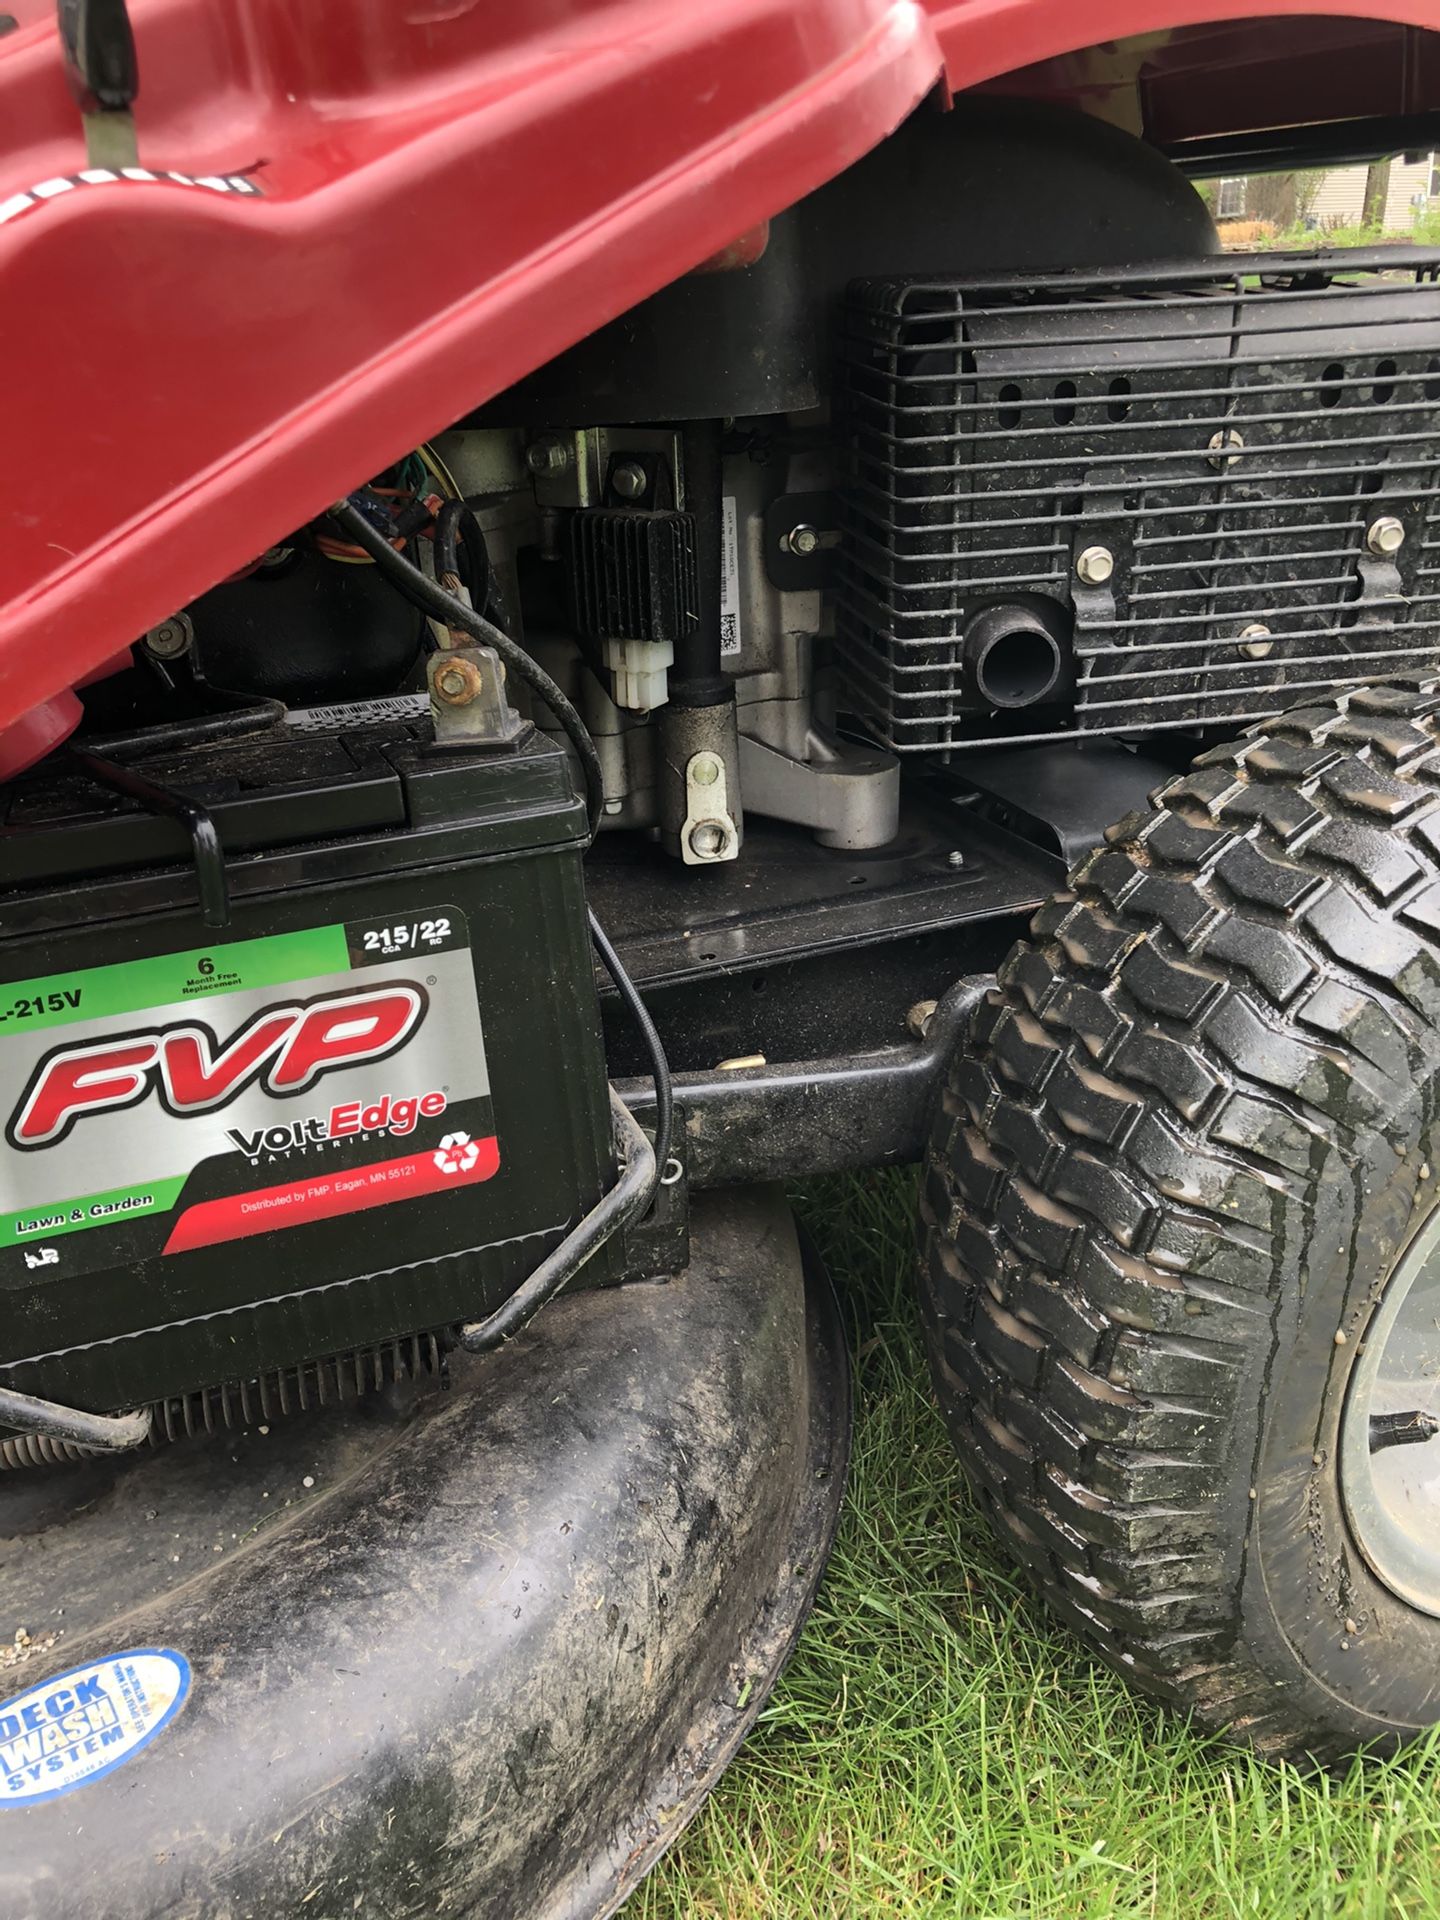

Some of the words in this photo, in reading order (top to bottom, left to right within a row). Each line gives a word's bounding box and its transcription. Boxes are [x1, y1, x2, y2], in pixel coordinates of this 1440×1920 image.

[363, 918, 452, 950] 215/22
[381, 944, 401, 954] CCA
[429, 937, 442, 946] RC
[186, 976, 215, 986] Month
[217, 972, 237, 980] Free
[198, 957, 215, 975] 6
[182, 979, 242, 994] Replacement
[10, 984, 424, 1148] FVP
[225, 1090, 447, 1158] VoltEdge
[250, 1129, 386, 1166] BATTERIES
[241, 1191, 292, 1214] Distributed
[293, 1189, 306, 1204] by
[369, 1172, 386, 1185] MN
[388, 1164, 417, 1181] 55121
[16, 1214, 65, 1235] Lawn
[71, 1208, 84, 1222] &
[90, 1195, 154, 1217] Garden
[0, 1674, 108, 1743] DECK
[0, 1696, 118, 1774] WASH
[7, 1725, 124, 1791] SYSTEM
